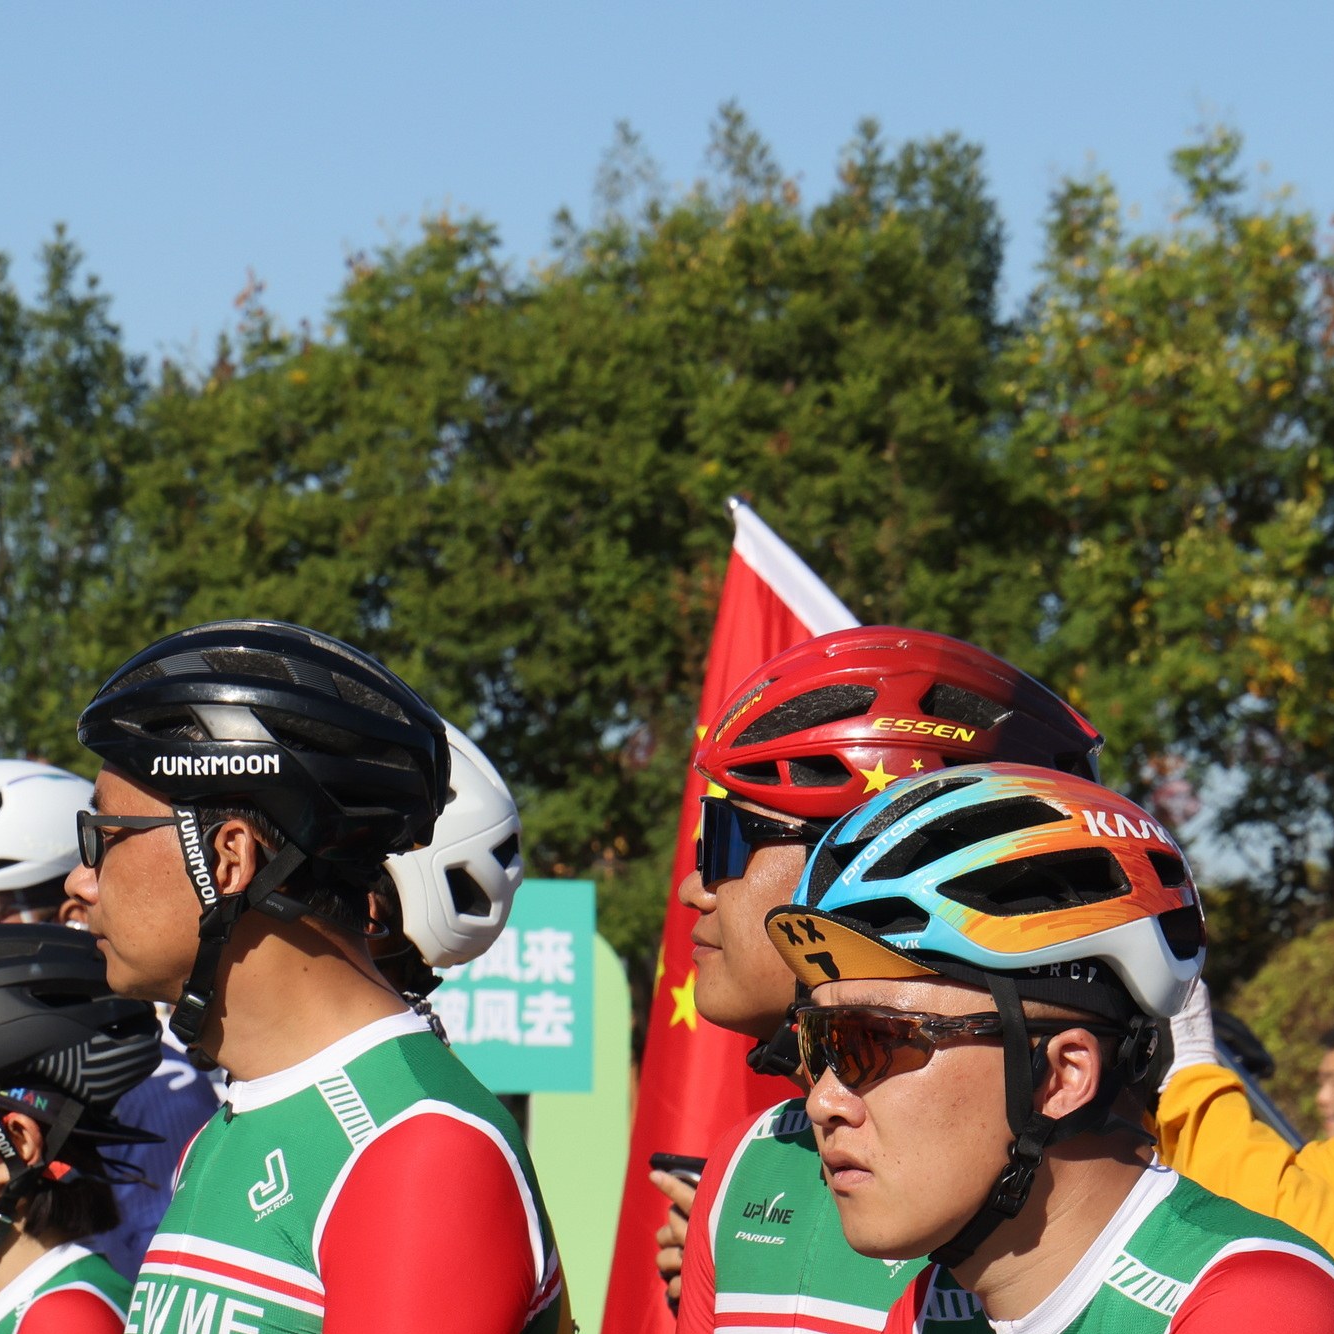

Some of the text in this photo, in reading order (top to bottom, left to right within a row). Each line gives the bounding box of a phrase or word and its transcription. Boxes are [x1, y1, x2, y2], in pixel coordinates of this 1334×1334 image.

[715, 692, 763, 743] ESSEN
[871, 717, 977, 743] ESSEN
[433, 926, 575, 984] 风来
[254, 1193, 295, 1223] JAKROO
[734, 1230, 787, 1246] PARDUS
